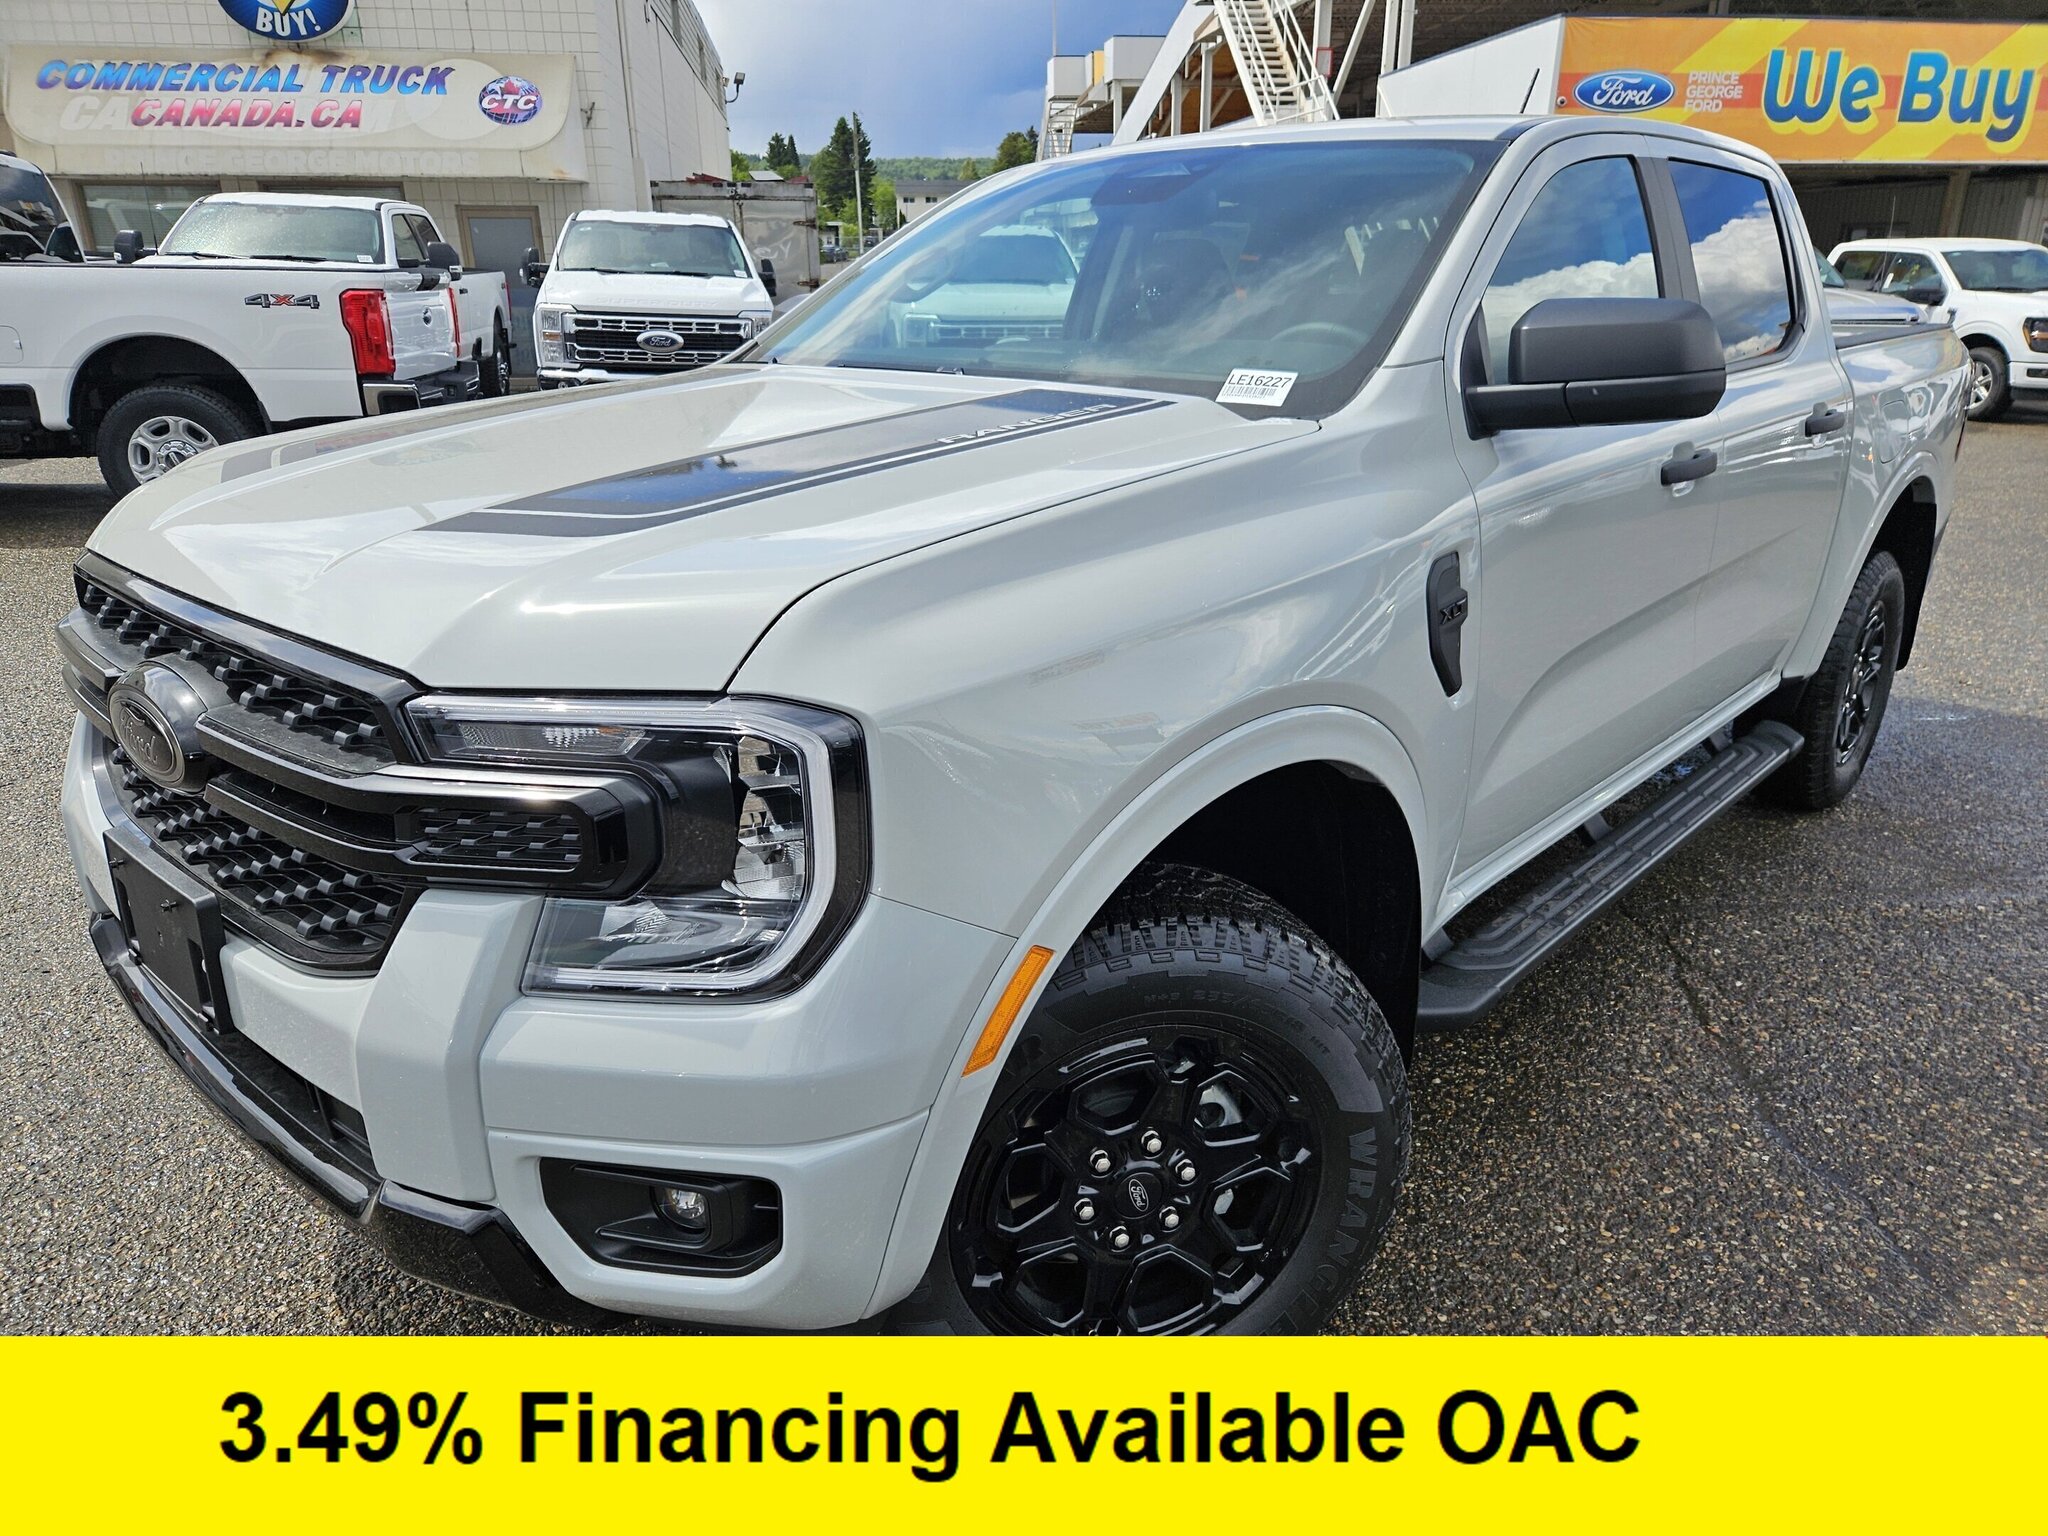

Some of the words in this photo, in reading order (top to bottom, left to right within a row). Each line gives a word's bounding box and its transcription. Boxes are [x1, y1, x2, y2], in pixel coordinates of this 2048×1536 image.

[256, 7, 321, 36] BUY!
[35, 59, 304, 93] COMMERCIAL
[319, 64, 456, 95] TRUCK
[1688, 72, 1740, 84] PRINCE
[1592, 75, 1656, 106] Ford
[1685, 85, 1743, 99] GEORGE
[1763, 49, 1880, 123] We
[1898, 50, 2036, 143] Buy
[131, 98, 363, 128] CANADA.CA
[481, 94, 538, 111] CTC
[1684, 99, 1723, 112] FORD
[649, 336, 672, 348] Ford
[1228, 373, 1292, 389] LE16227
[935, 403, 1118, 443] RANGER
